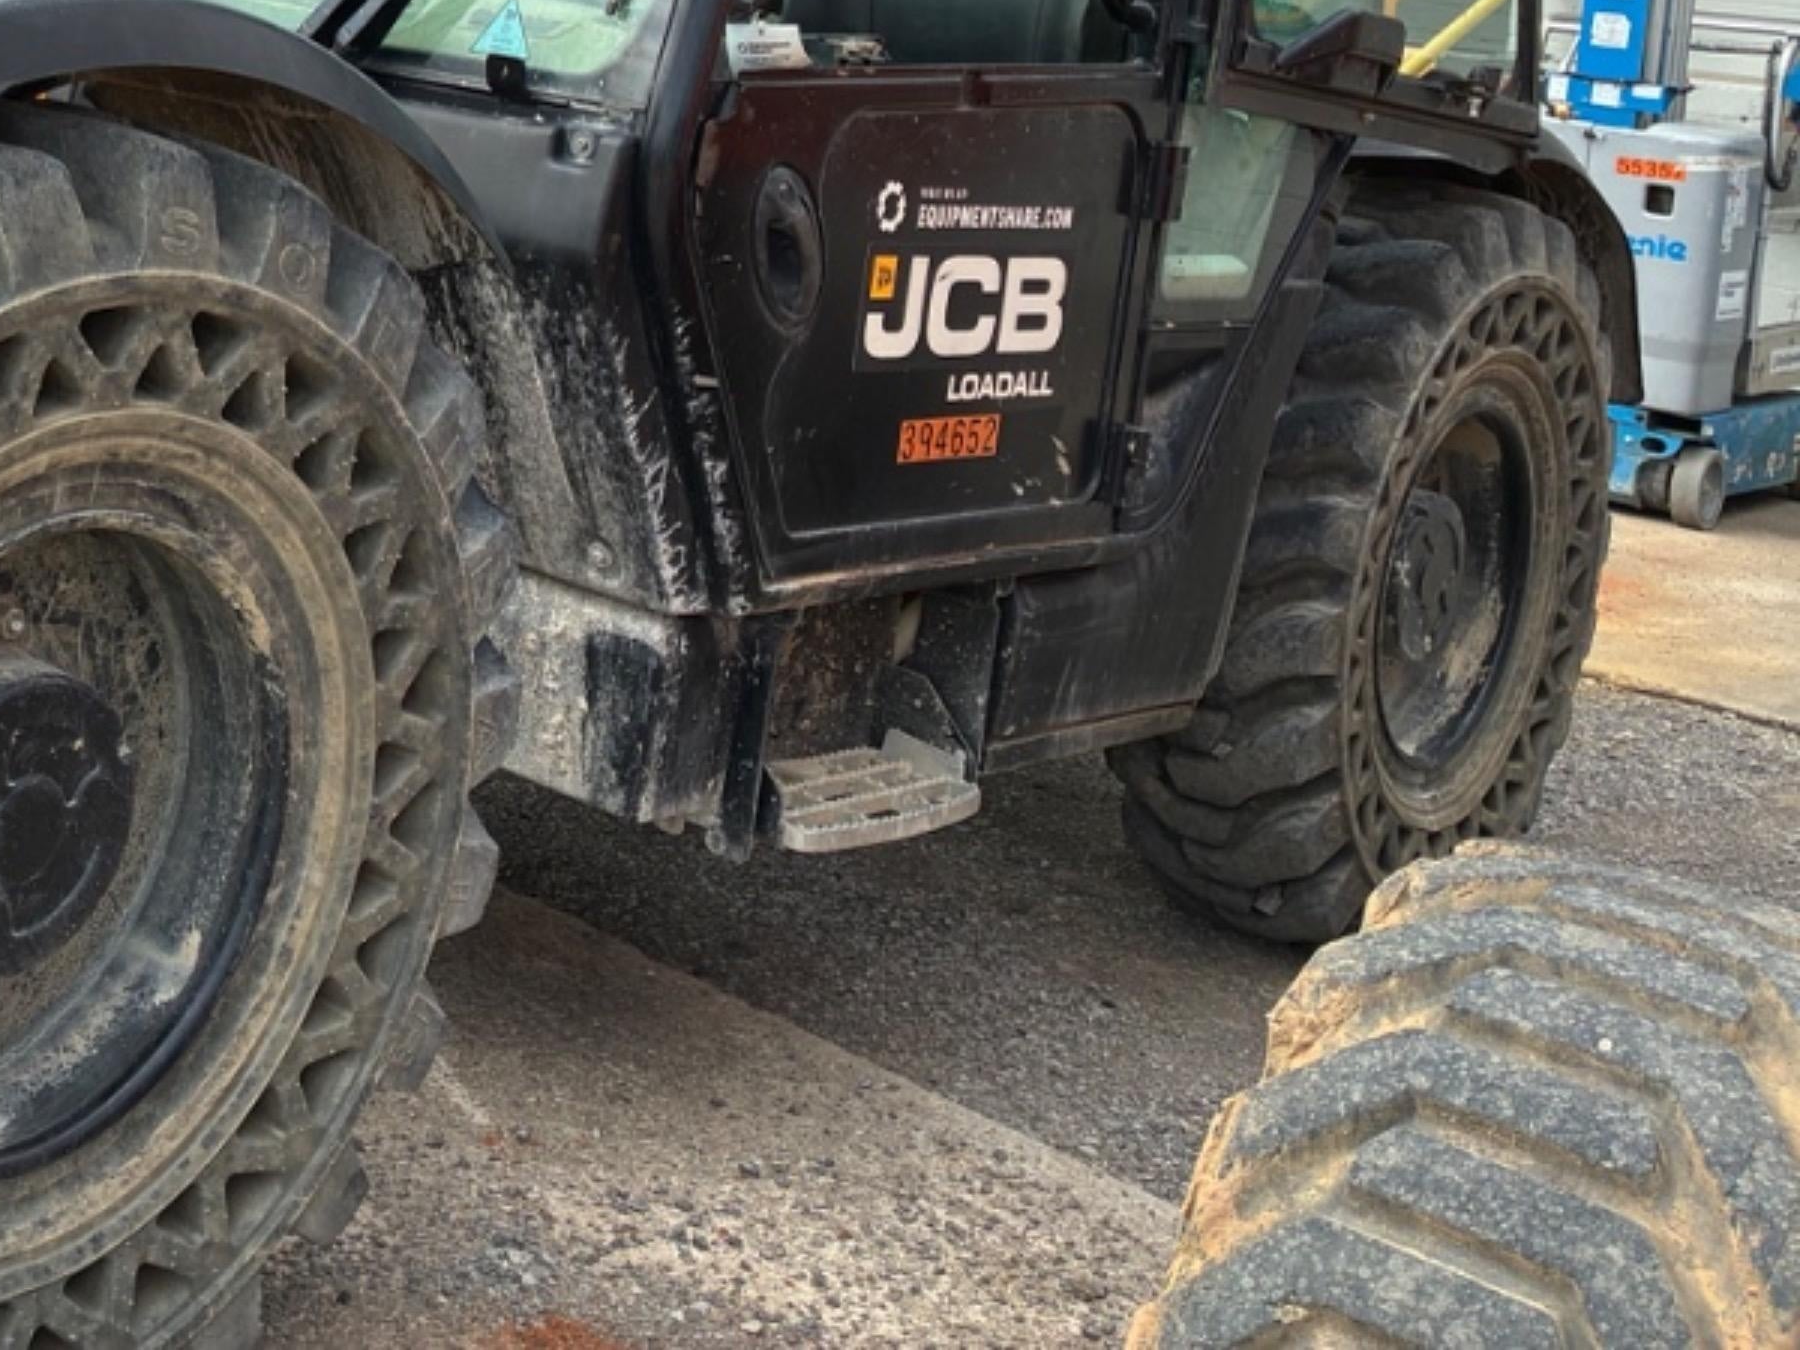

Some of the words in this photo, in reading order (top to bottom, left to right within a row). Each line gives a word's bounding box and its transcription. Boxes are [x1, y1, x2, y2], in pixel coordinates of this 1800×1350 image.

[917, 204, 1074, 230] EQUIPMENTSHARE.COM
[1626, 236, 1687, 261] enie
[863, 255, 1068, 358] JCB
[947, 371, 1053, 401] LOADALL
[901, 418, 997, 461] 394652
